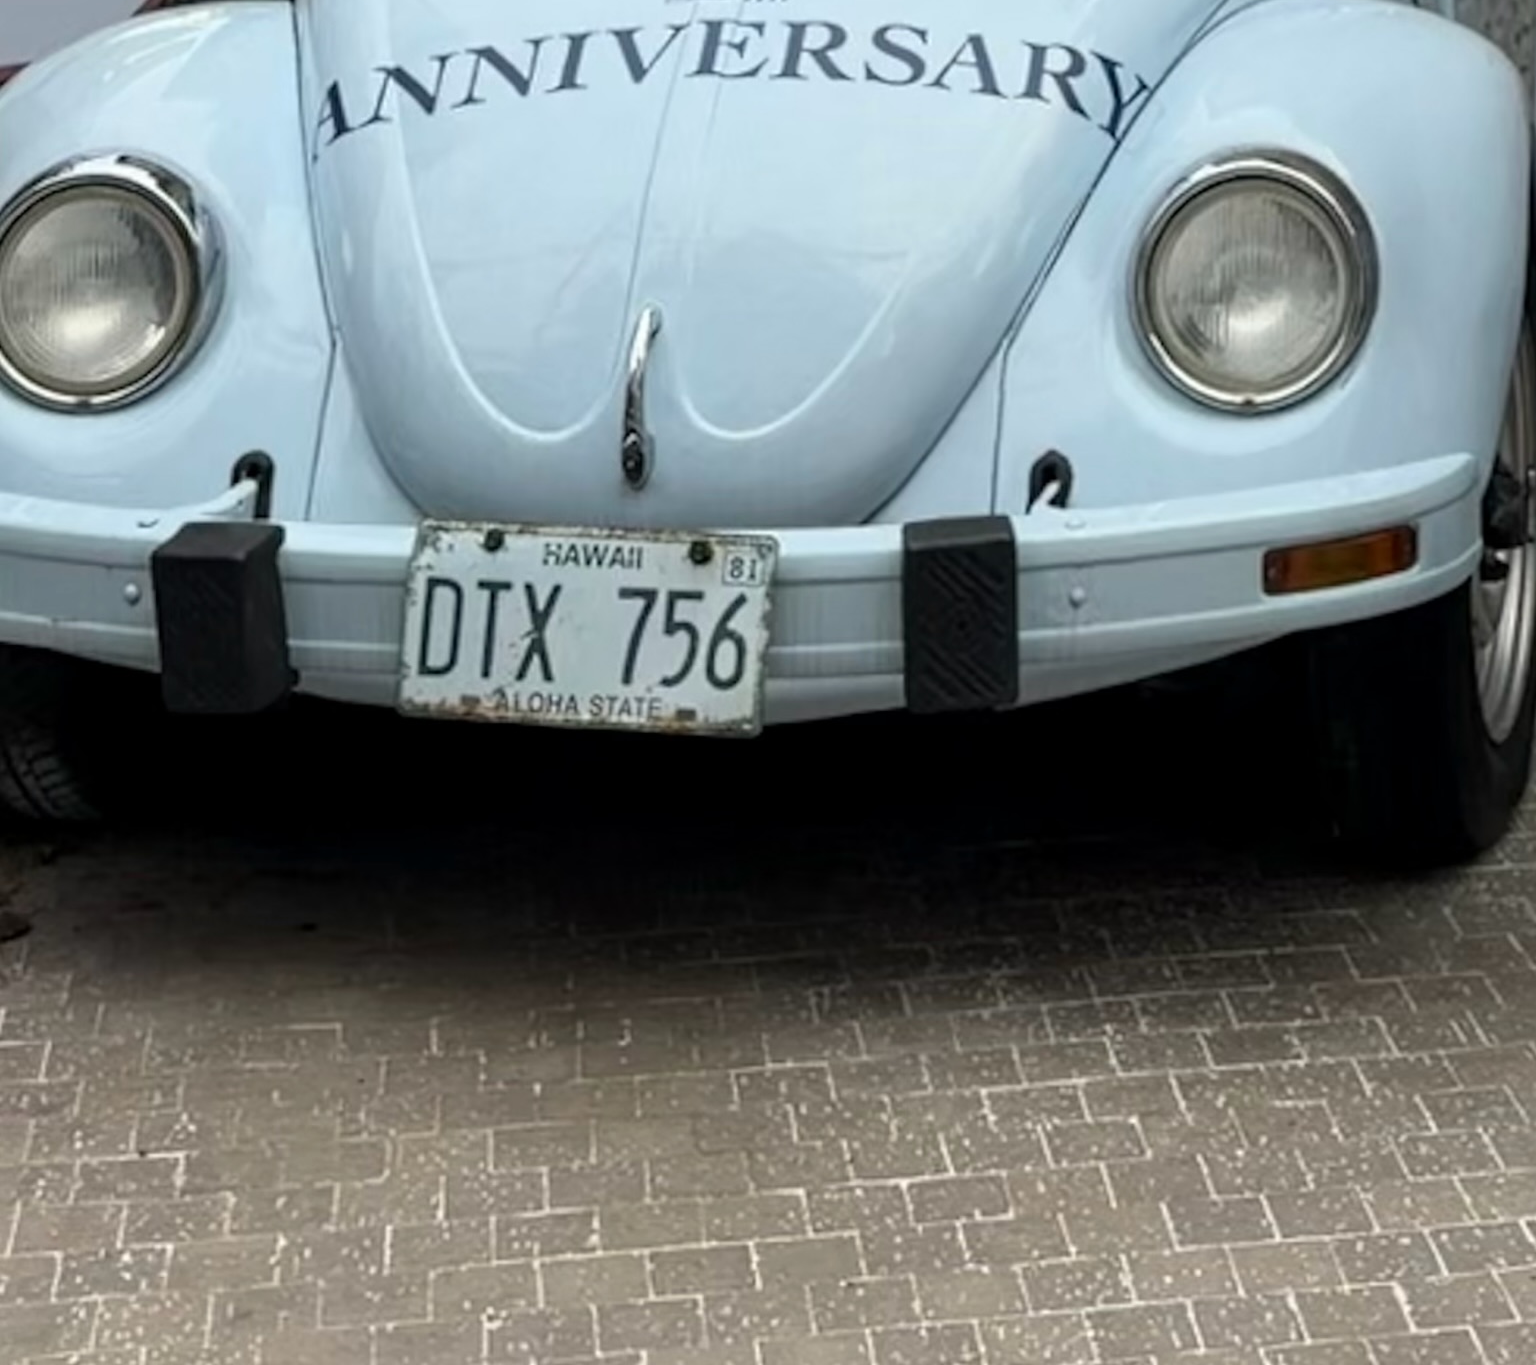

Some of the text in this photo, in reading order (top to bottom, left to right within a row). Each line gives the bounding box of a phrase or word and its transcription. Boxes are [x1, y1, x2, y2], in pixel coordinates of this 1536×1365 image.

[313, 20, 1152, 161] ANNIVERSARY
[541, 542, 644, 571] HAWAII
[729, 555, 757, 581] 81
[417, 576, 748, 690] DTX 756
[493, 687, 663, 722] ALOHA STATE
